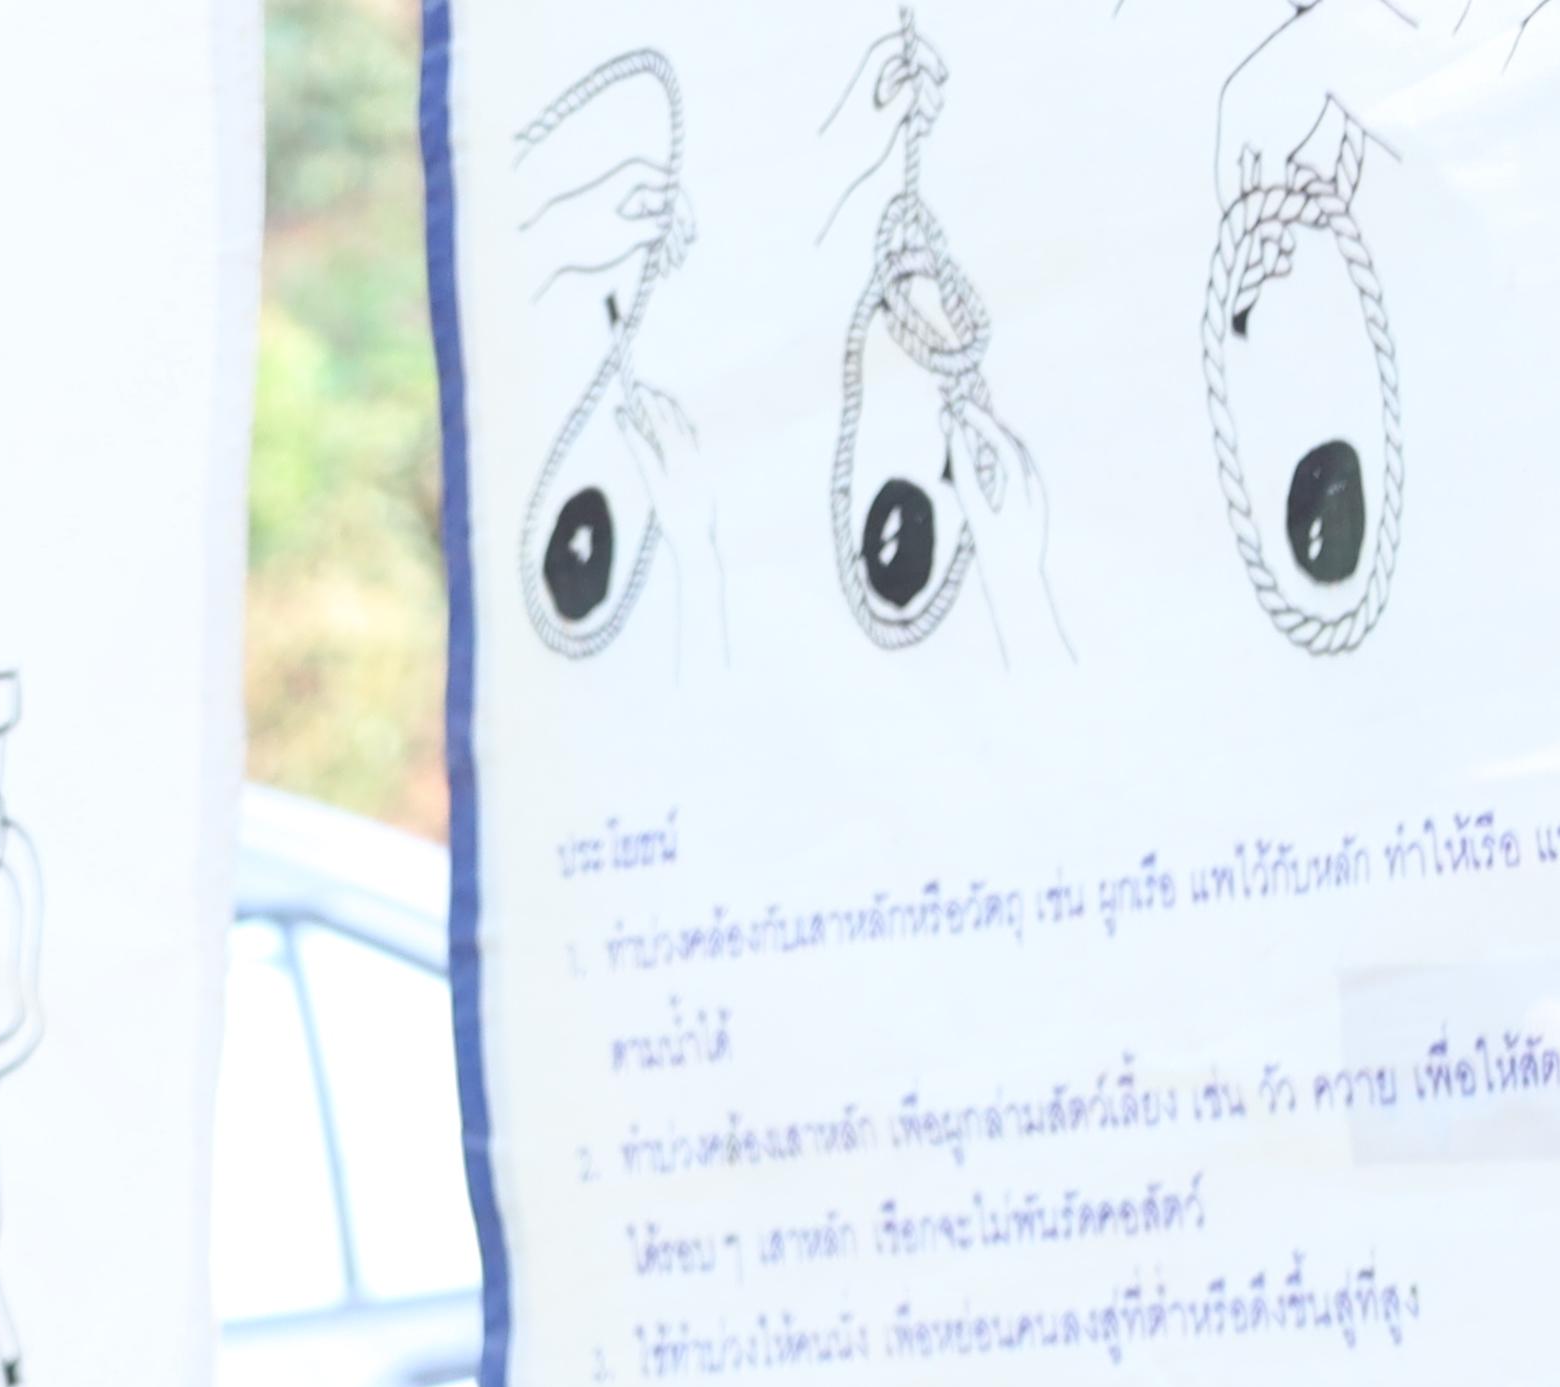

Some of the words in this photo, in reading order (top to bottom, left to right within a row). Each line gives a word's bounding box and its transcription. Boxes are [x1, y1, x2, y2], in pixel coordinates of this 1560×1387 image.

[1036, 861, 1085, 923] เช่น
[1099, 850, 1176, 939] ผูกเรือ
[1190, 834, 1371, 905] แพไว้กับหลัก
[1384, 809, 1521, 881] ทำให้เรือ
[1192, 1064, 1247, 1122] เช่น
[1258, 1062, 1297, 1114] วัว
[1312, 1065, 1399, 1112] ควาย
